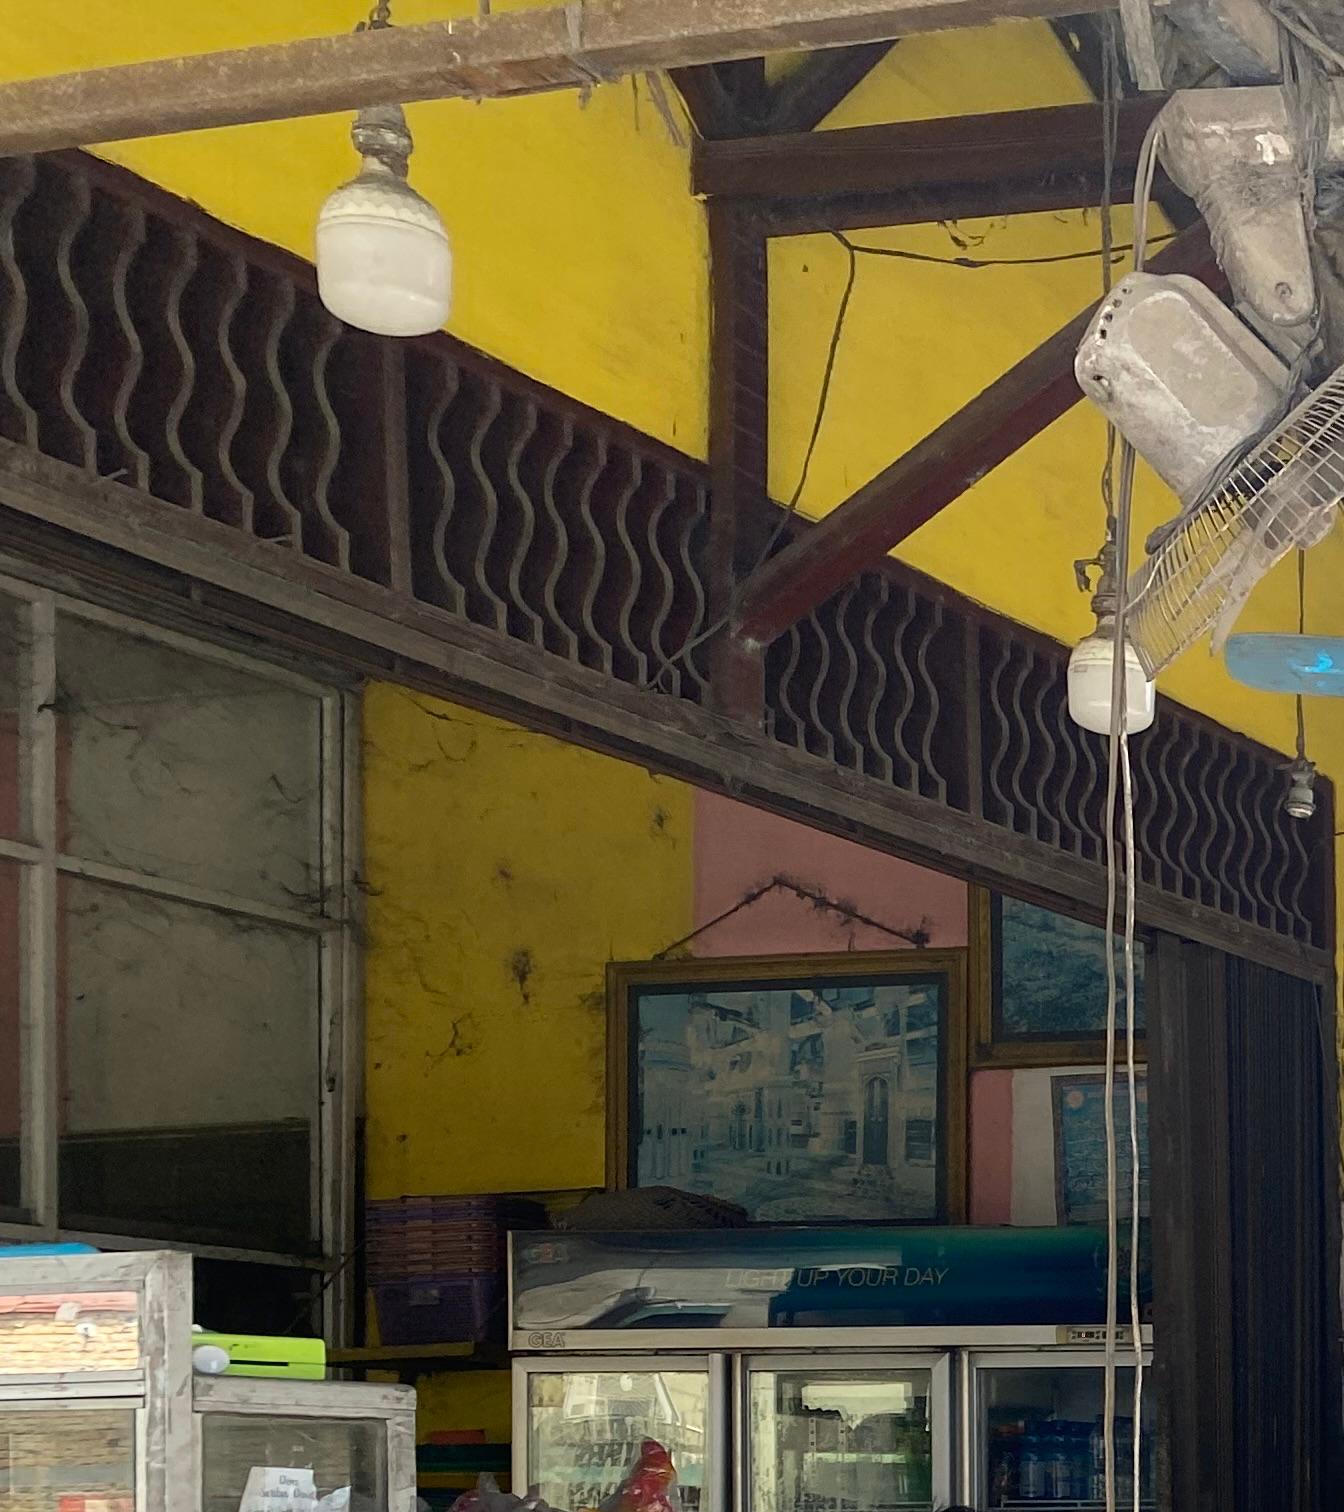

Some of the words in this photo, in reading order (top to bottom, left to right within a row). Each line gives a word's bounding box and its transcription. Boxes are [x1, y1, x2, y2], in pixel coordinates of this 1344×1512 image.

[799, 1268, 830, 1288] UP
[836, 1267, 898, 1287] YOUR
[904, 1266, 949, 1287] DAY
[528, 1331, 567, 1348] GEA
